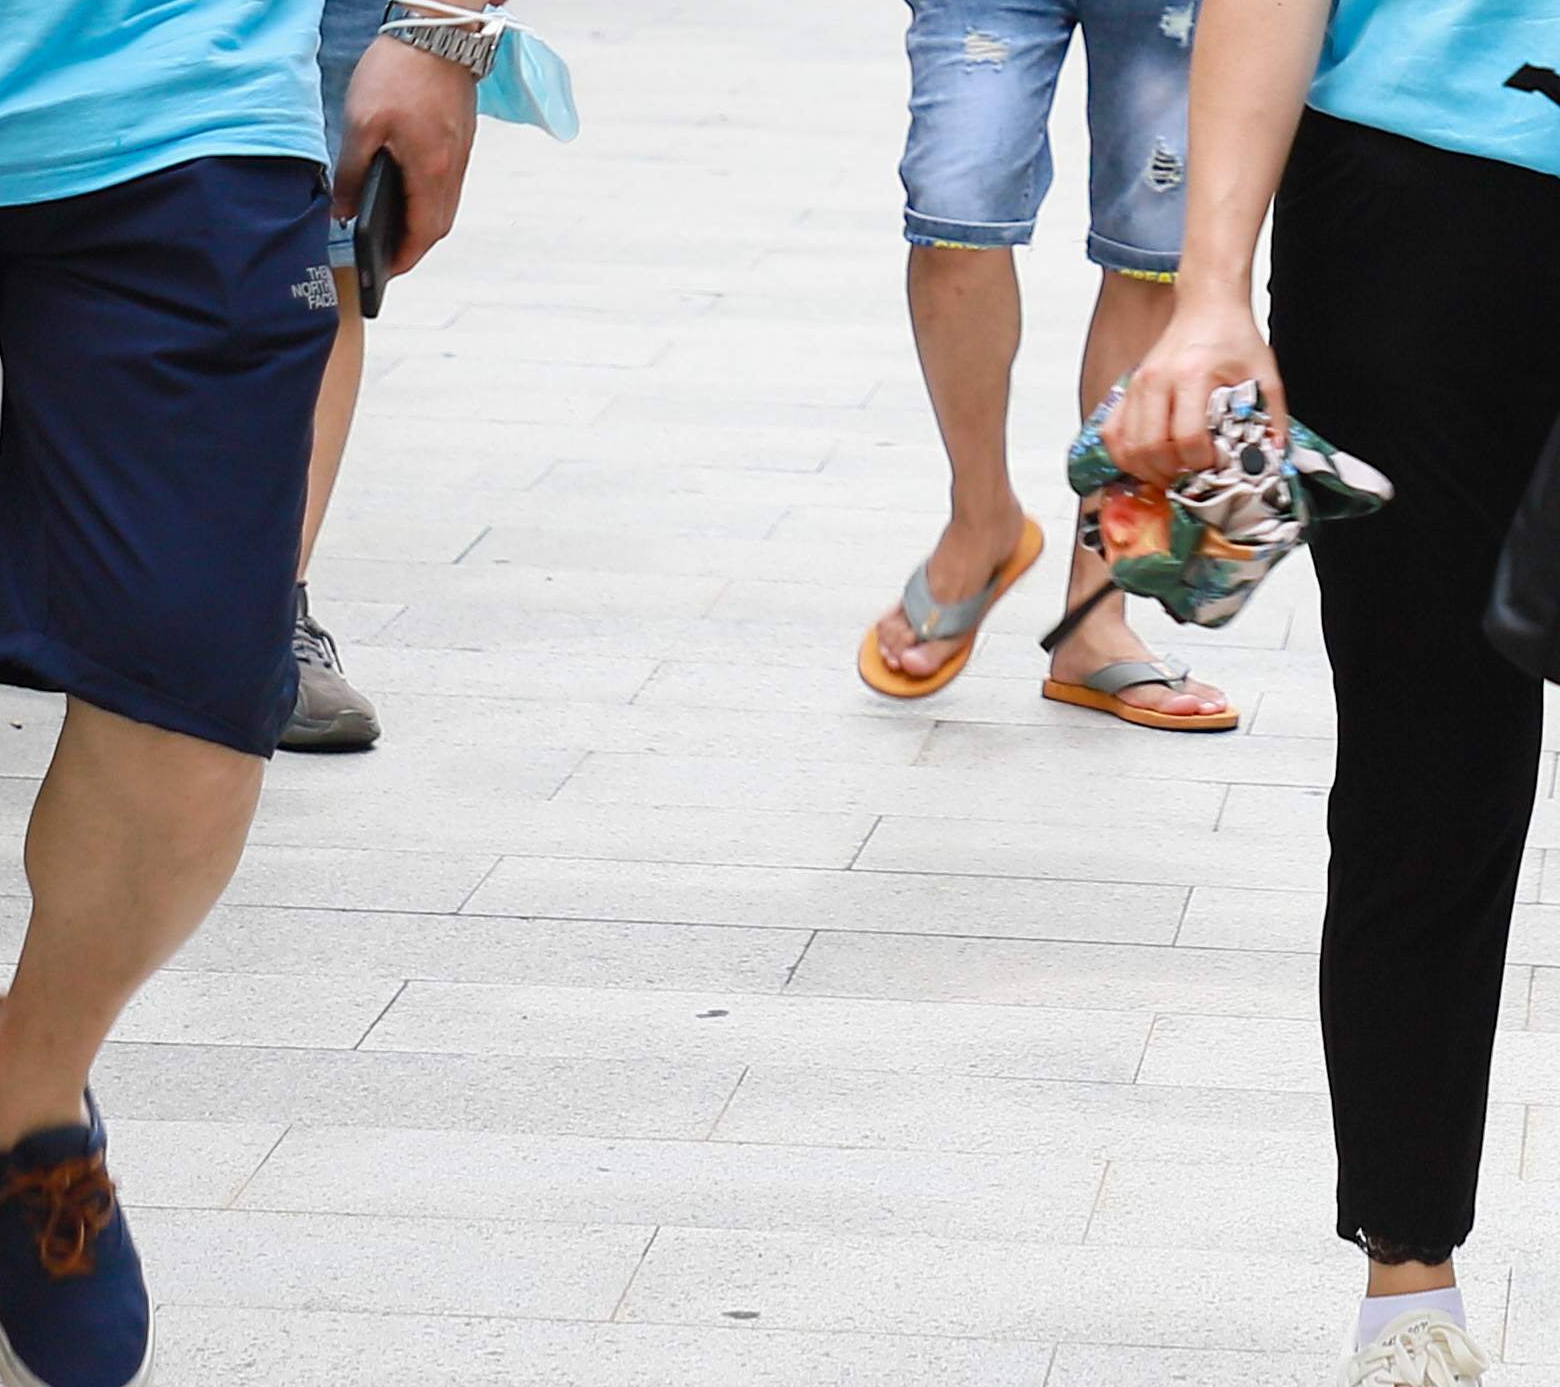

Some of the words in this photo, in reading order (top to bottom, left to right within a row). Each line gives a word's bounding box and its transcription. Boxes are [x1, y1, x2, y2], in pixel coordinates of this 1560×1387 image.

[306, 265, 330, 281] THE
[291, 280, 333, 299] NORTH
[308, 293, 338, 310] FACE
